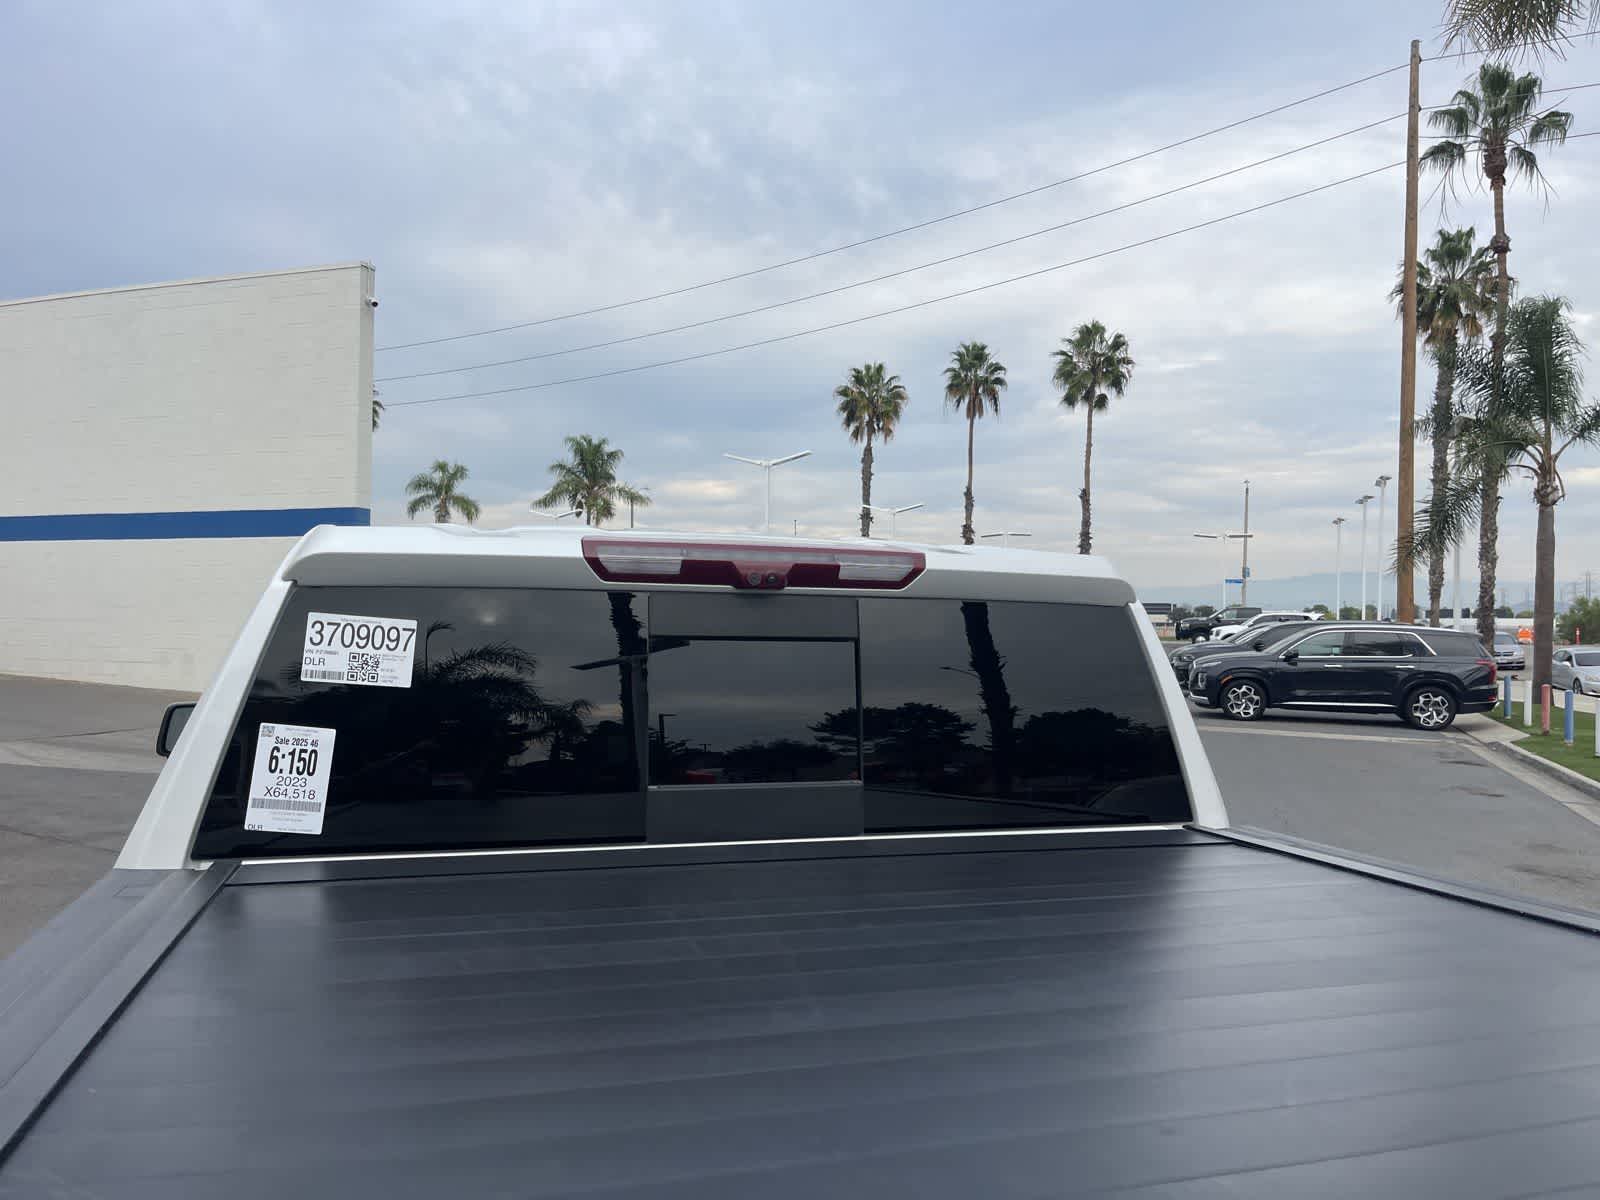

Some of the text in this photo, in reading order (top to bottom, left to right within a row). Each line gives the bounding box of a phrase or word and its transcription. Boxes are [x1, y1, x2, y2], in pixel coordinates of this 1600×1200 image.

[310, 620, 415, 652] 3709097
[304, 656, 325, 666] DLR
[275, 736, 290, 745] Sale
[291, 738, 308, 747] 2025
[268, 745, 318, 777] 6:150
[276, 775, 307, 788] 2023
